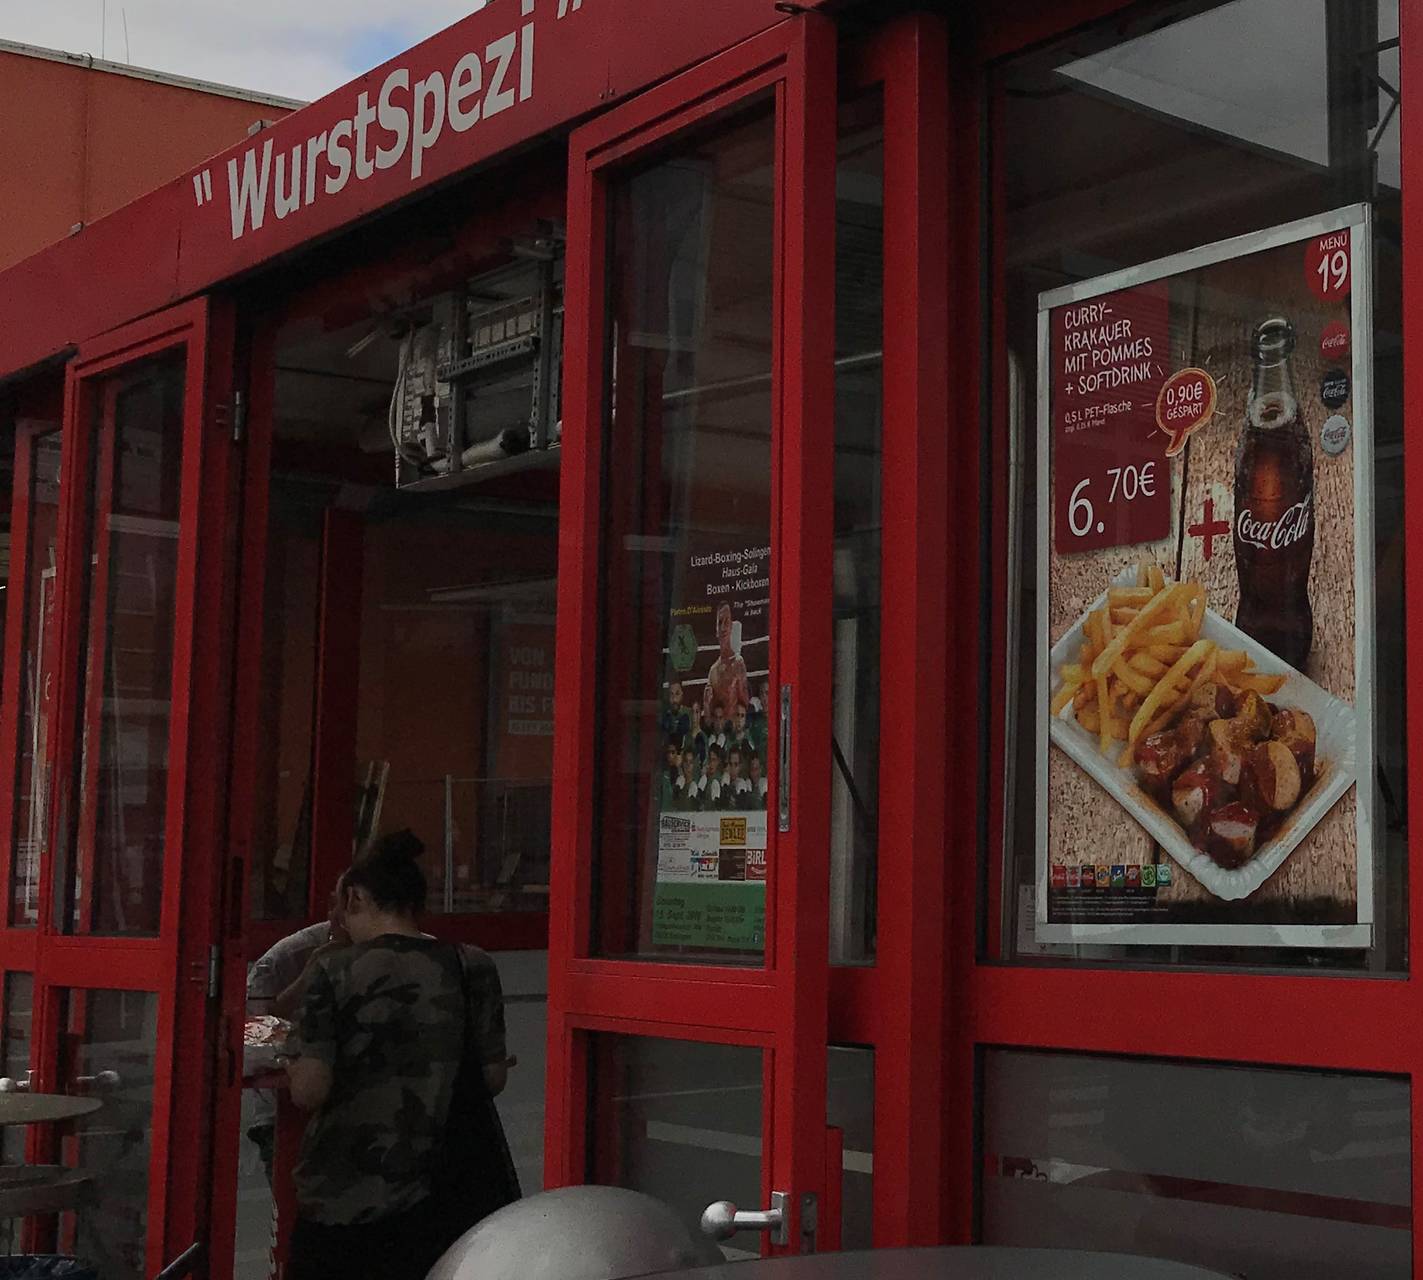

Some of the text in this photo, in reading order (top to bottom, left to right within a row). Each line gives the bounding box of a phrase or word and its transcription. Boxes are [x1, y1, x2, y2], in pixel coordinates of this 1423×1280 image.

[228, 0, 536, 240] WurstSpezi
[1317, 250, 1349, 293] 19
[1064, 302, 1113, 330] CURRY-
[1064, 319, 1132, 352] KRAKAUER
[1064, 336, 1153, 375] MIT POMMES
[1077, 361, 1152, 395] SOFTDRINK
[1166, 381, 1204, 407] 0,90€
[1084, 400, 1132, 419] PET-Flasche
[1166, 402, 1204, 420] GESPART
[1237, 490, 1312, 550] Coca-Cola
[706, 583, 730, 596] Boxen
